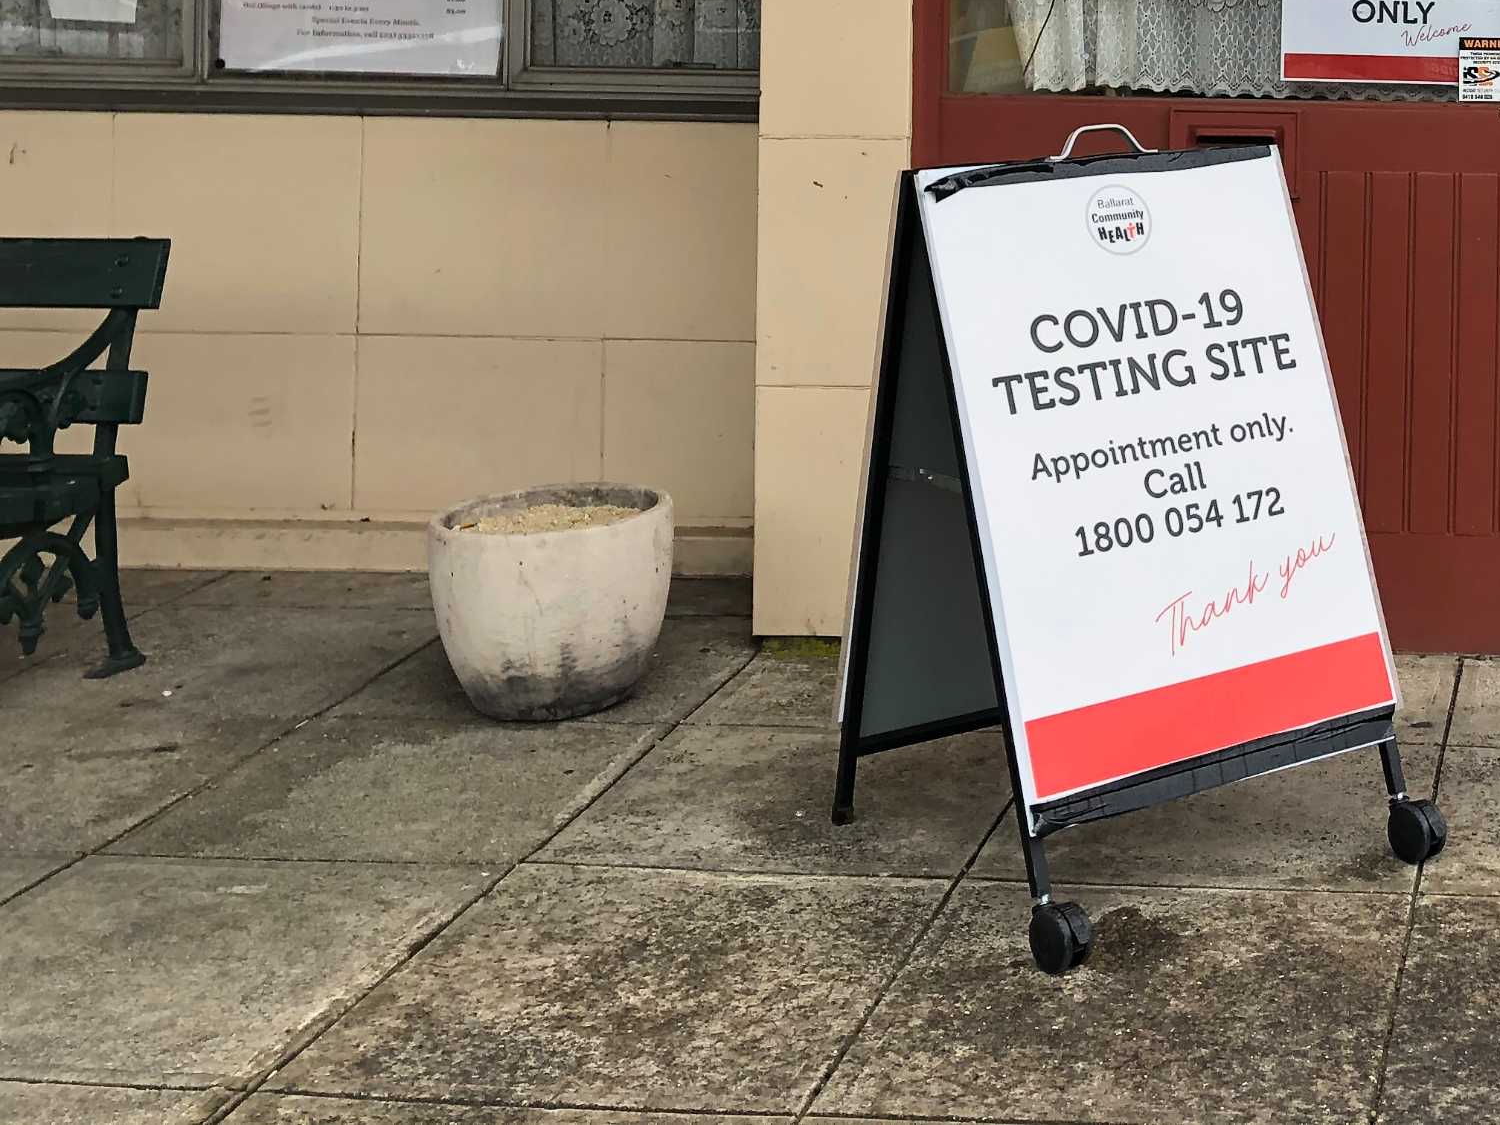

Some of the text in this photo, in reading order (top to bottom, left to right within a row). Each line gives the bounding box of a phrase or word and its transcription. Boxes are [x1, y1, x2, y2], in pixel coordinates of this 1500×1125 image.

[1352, 0, 1435, 24] ONLY
[1401, 23, 1473, 47] Welcome
[1091, 209, 1144, 224] Community
[1097, 197, 1134, 209] Ballarat
[1098, 221, 1144, 243] HEALTH
[1030, 288, 1244, 355] COVID-19
[992, 333, 1297, 415] TESTING SITE
[1030, 412, 1294, 484] Appointment only.
[1143, 461, 1207, 499] Call
[1074, 486, 1285, 558] 1800 054 172
[1155, 532, 1336, 656] Thank you
